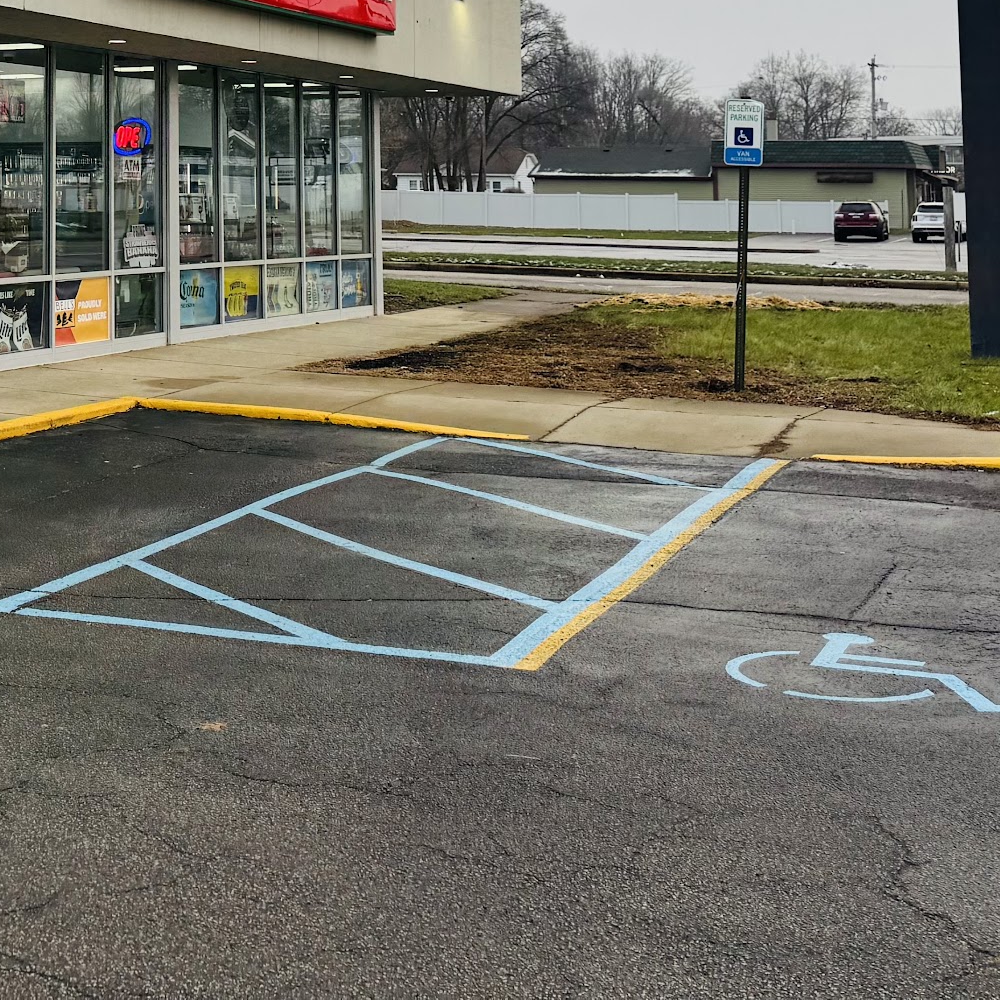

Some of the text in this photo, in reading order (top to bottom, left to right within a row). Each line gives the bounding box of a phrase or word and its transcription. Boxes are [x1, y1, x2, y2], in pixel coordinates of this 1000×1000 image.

[728, 104, 761, 113] RESERVED
[730, 113, 759, 122] PARKING
[124, 159, 140, 172] ATM
[78, 299, 102, 310] PROUDLY
[77, 312, 93, 323] SOLD
[92, 311, 107, 321] HERE
